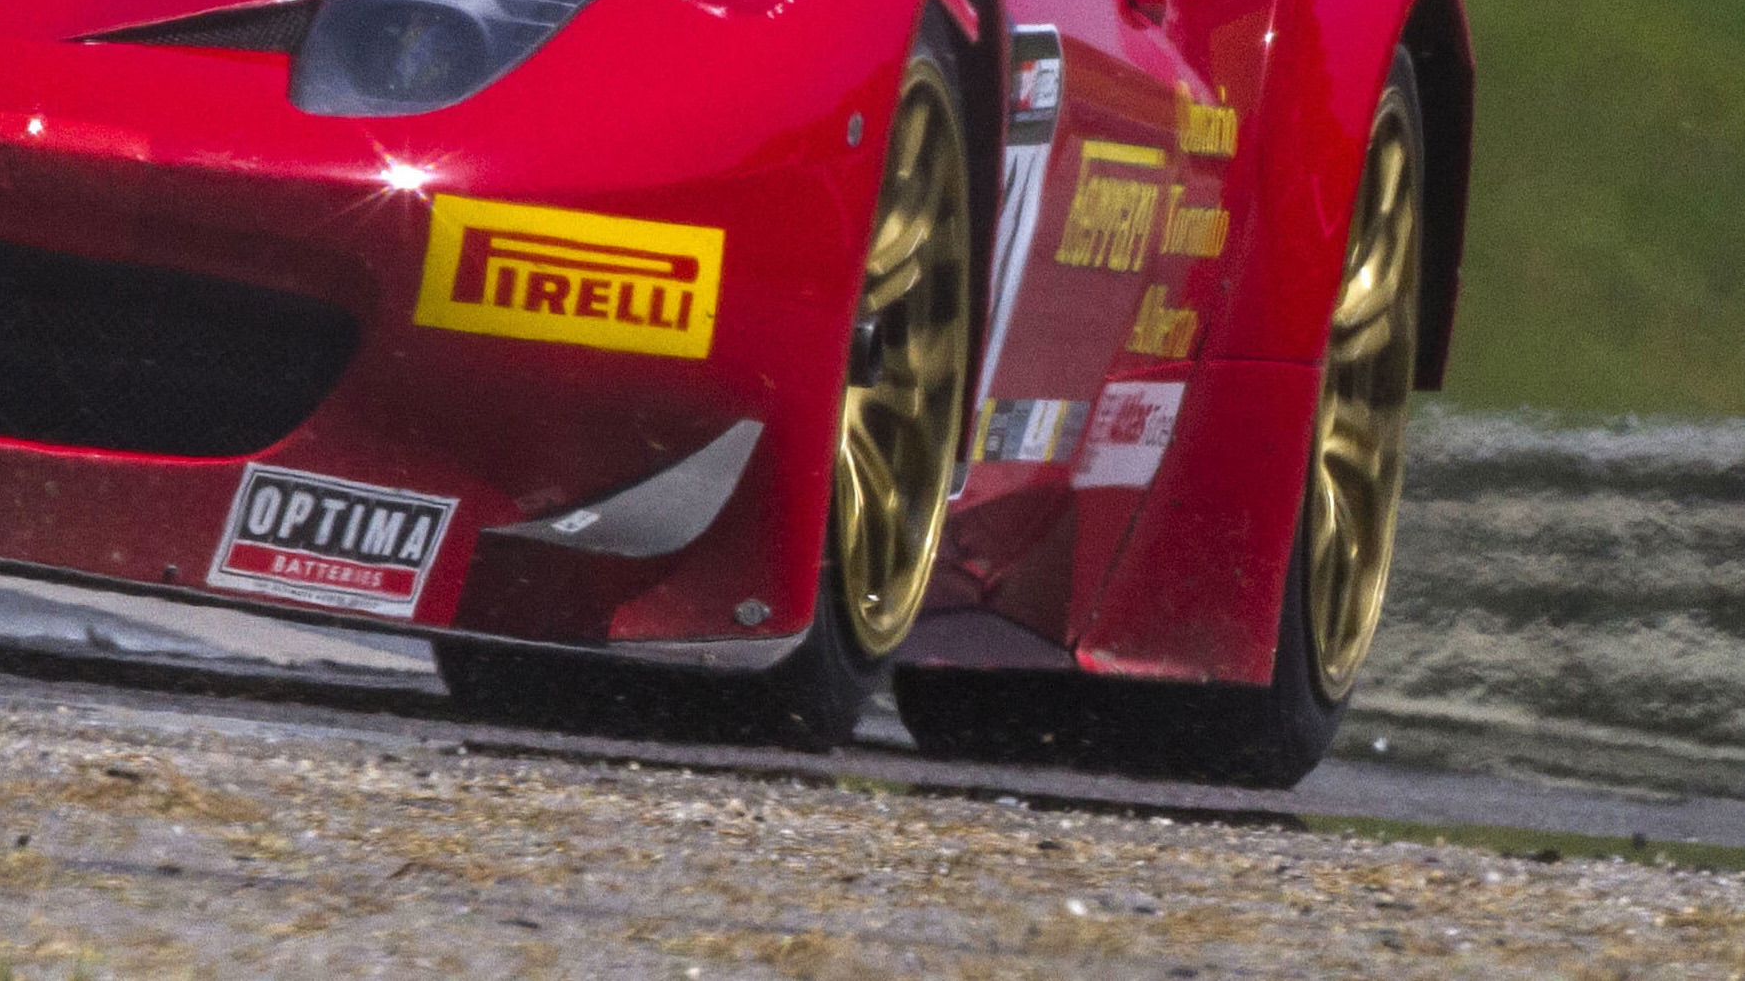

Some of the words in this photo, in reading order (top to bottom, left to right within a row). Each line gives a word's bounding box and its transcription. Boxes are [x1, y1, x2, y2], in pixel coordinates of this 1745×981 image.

[450, 225, 701, 332] PIRELLI
[247, 484, 432, 561] OPTIMA
[272, 554, 385, 589] BATTERIES
